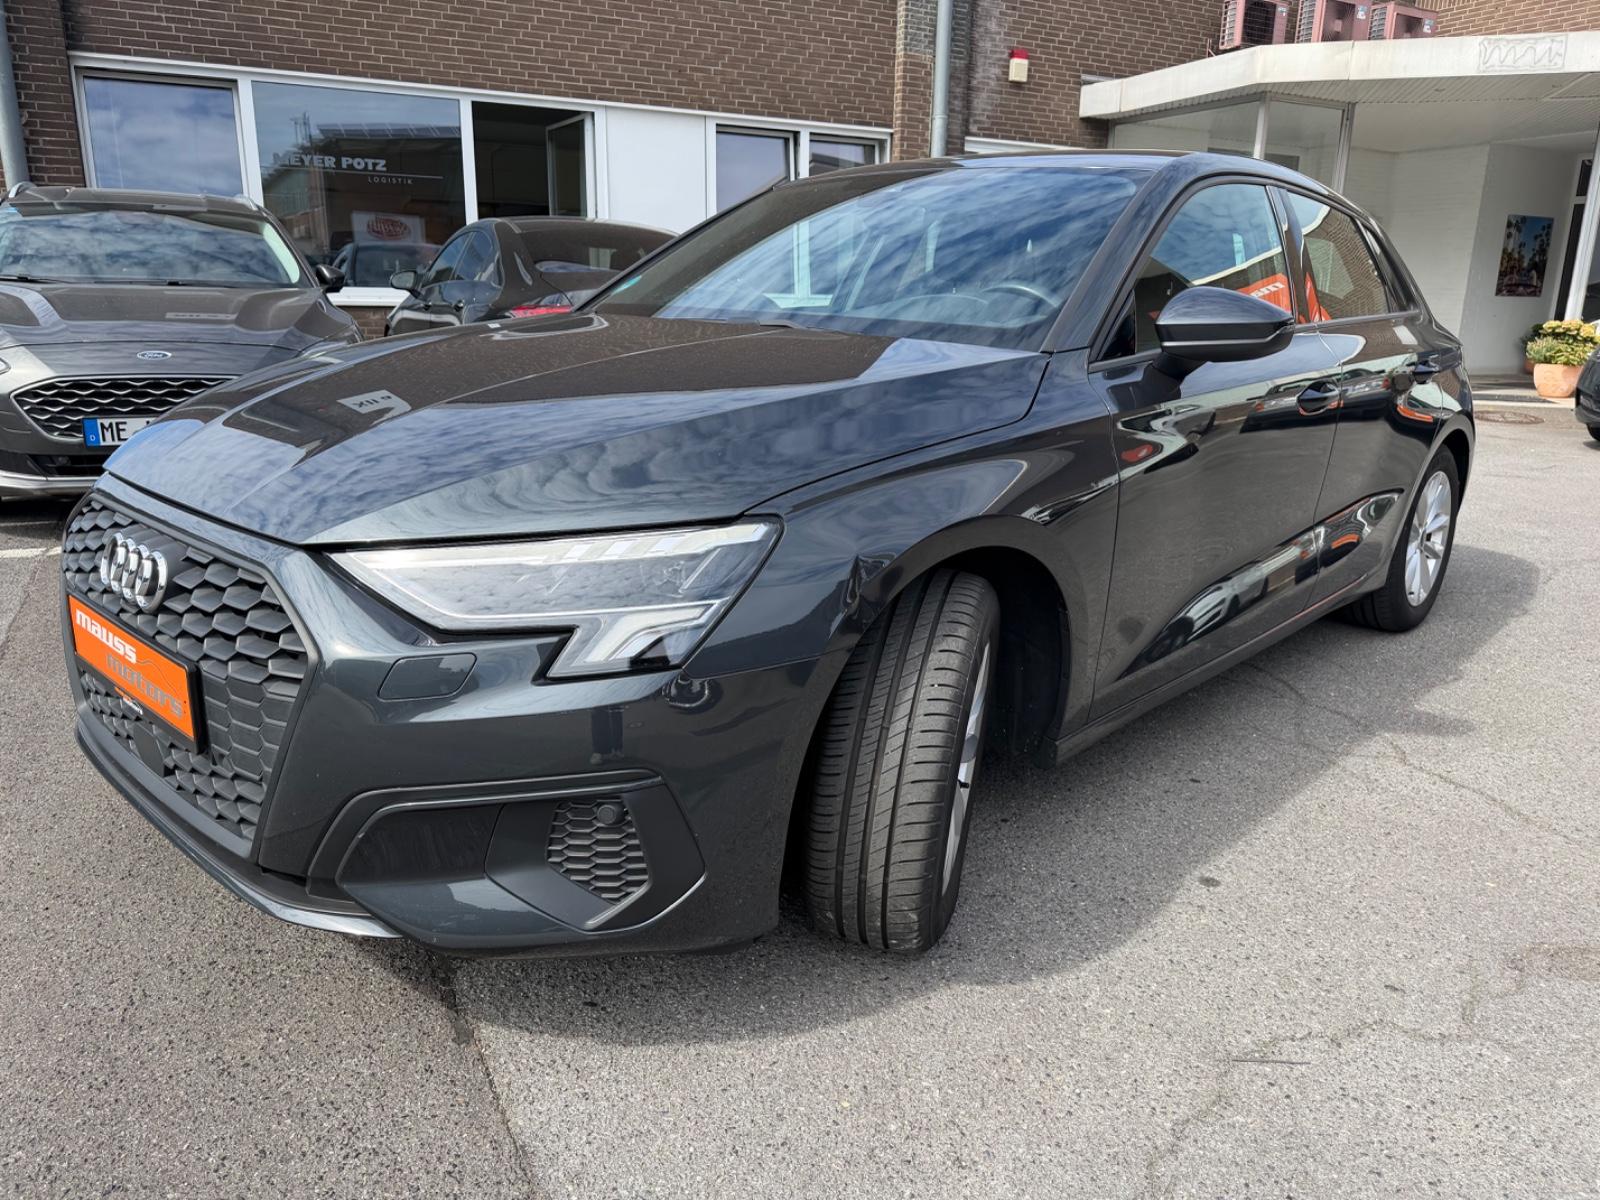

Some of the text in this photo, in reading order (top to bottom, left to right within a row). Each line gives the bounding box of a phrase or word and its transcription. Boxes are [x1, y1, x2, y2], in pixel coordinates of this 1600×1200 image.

[273, 151, 387, 172] MEYER POTZ
[367, 176, 414, 185] LOGISTIK
[100, 421, 128, 442] ME
[75, 608, 137, 665] mauss
[106, 653, 182, 720] motors
